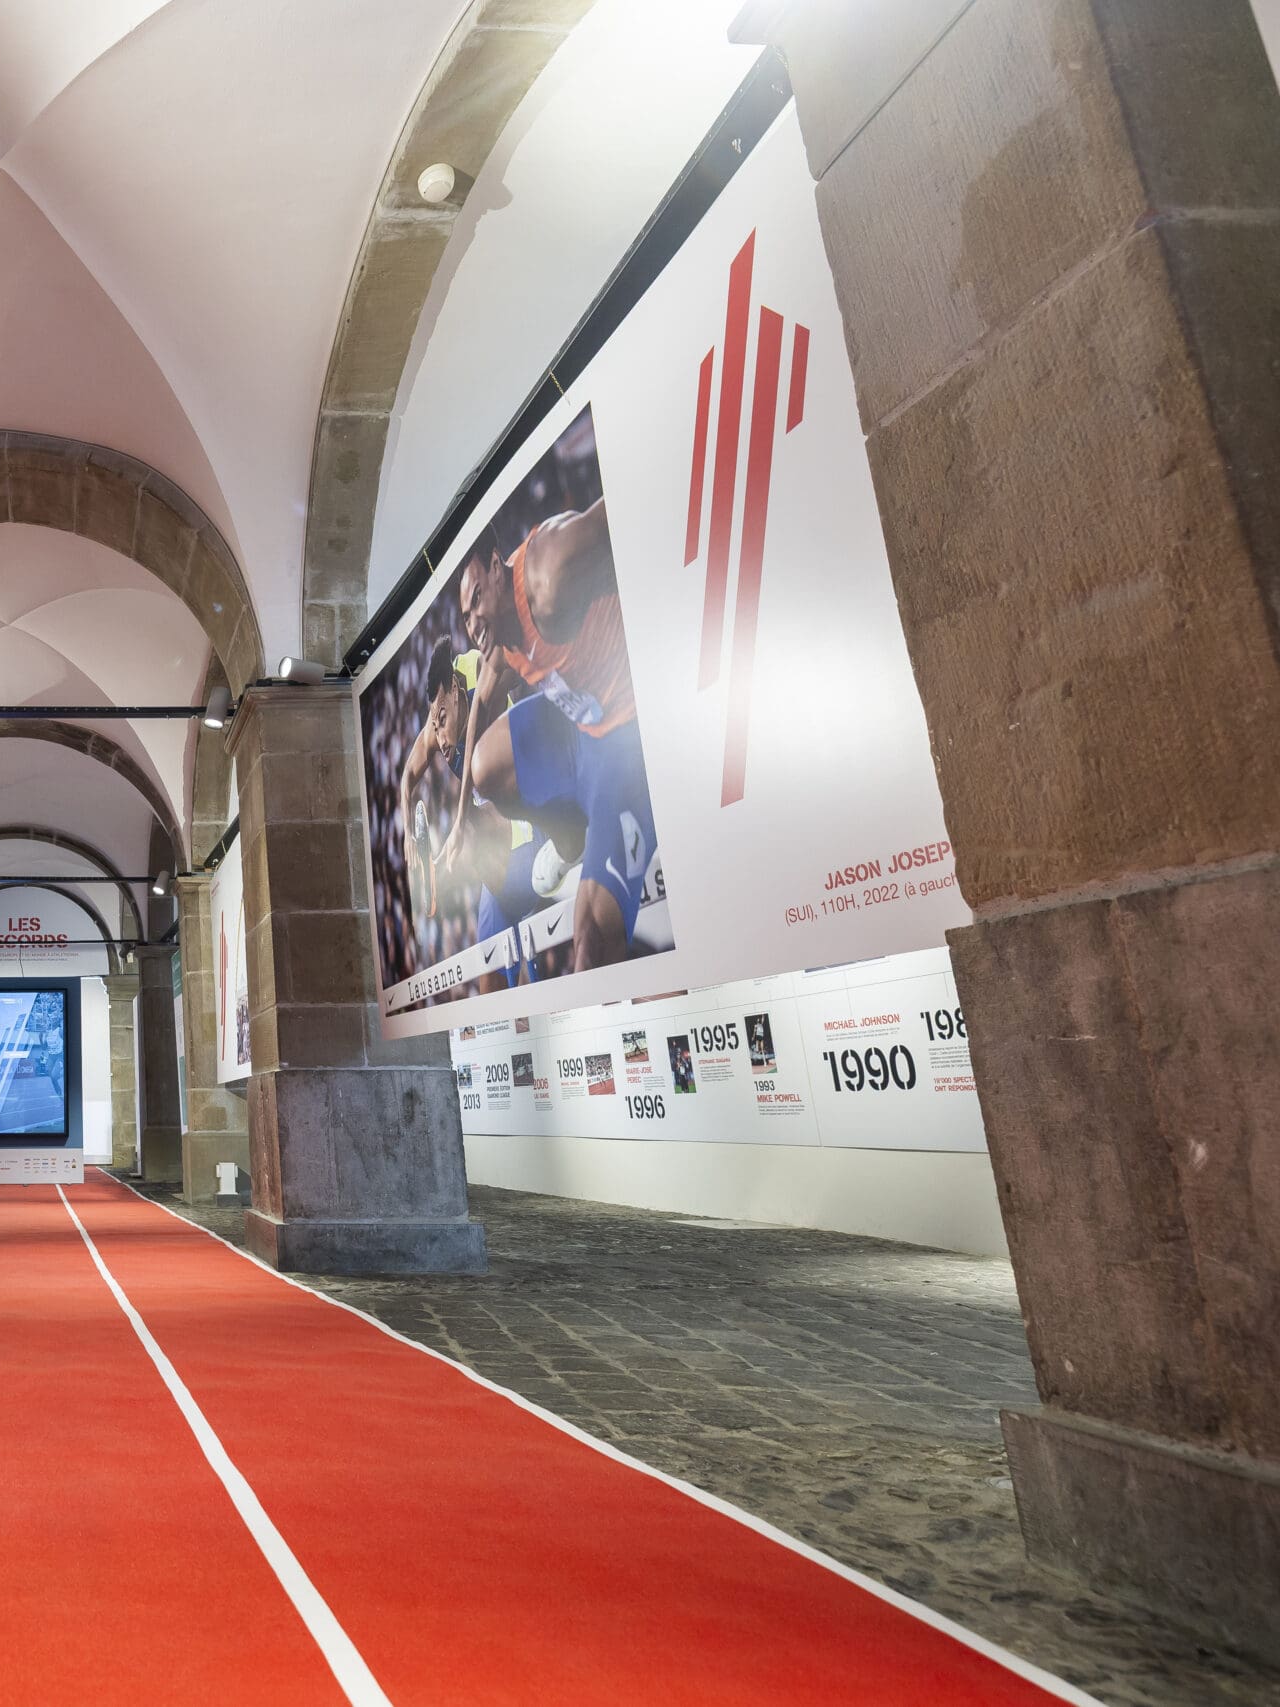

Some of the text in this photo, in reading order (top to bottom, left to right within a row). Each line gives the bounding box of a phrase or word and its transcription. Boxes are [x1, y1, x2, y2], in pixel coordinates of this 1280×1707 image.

[825, 841, 956, 890] JASON JOSEP
[785, 872, 958, 926] (SUI), 110H, 2022 (à gauch
[9, 918, 40, 931] LES
[408, 965, 463, 1002] Lausanne
[824, 1014, 900, 1030] MICHAEL JOHNSON
[920, 1008, 967, 1041] 198
[691, 1023, 739, 1053] 1995
[486, 1063, 509, 1083] 2009
[557, 1058, 583, 1078] 1999
[823, 1045, 916, 1091] 1990
[533, 1078, 549, 1090] 2006
[754, 1080, 775, 1091] 1993
[463, 1094, 481, 1110] 2013
[625, 1095, 665, 1119] 1996
[757, 1094, 802, 1103] MIKE POWELL
